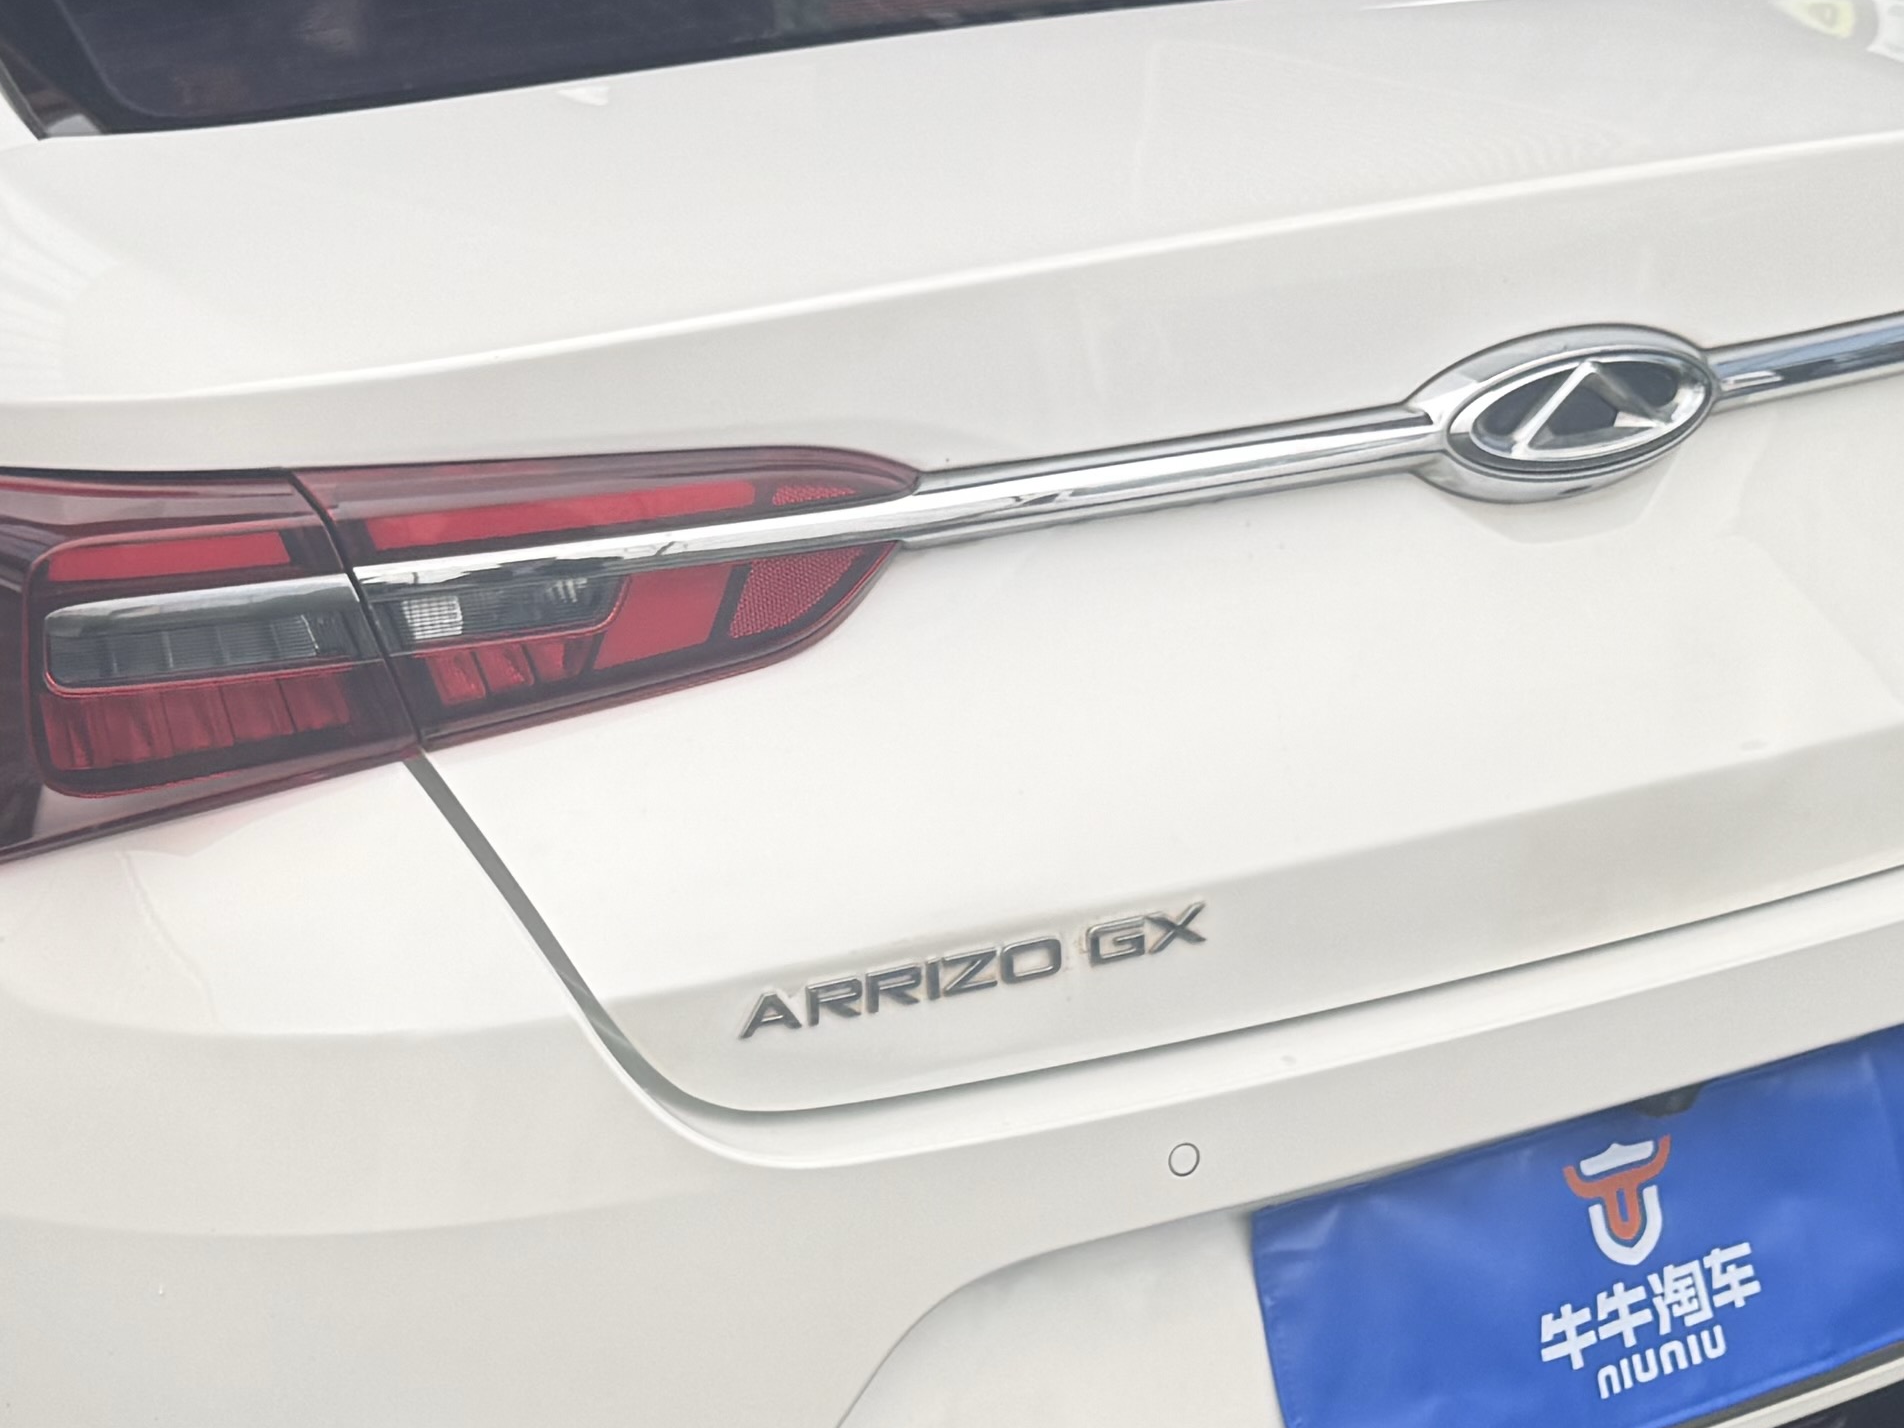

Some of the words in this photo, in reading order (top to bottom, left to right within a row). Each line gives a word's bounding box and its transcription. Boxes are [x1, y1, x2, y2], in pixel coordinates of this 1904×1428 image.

[737, 935, 1063, 1040] ARRIZO
[1085, 900, 1208, 967] GX
[1541, 1241, 1762, 1371] 牛牛淘车
